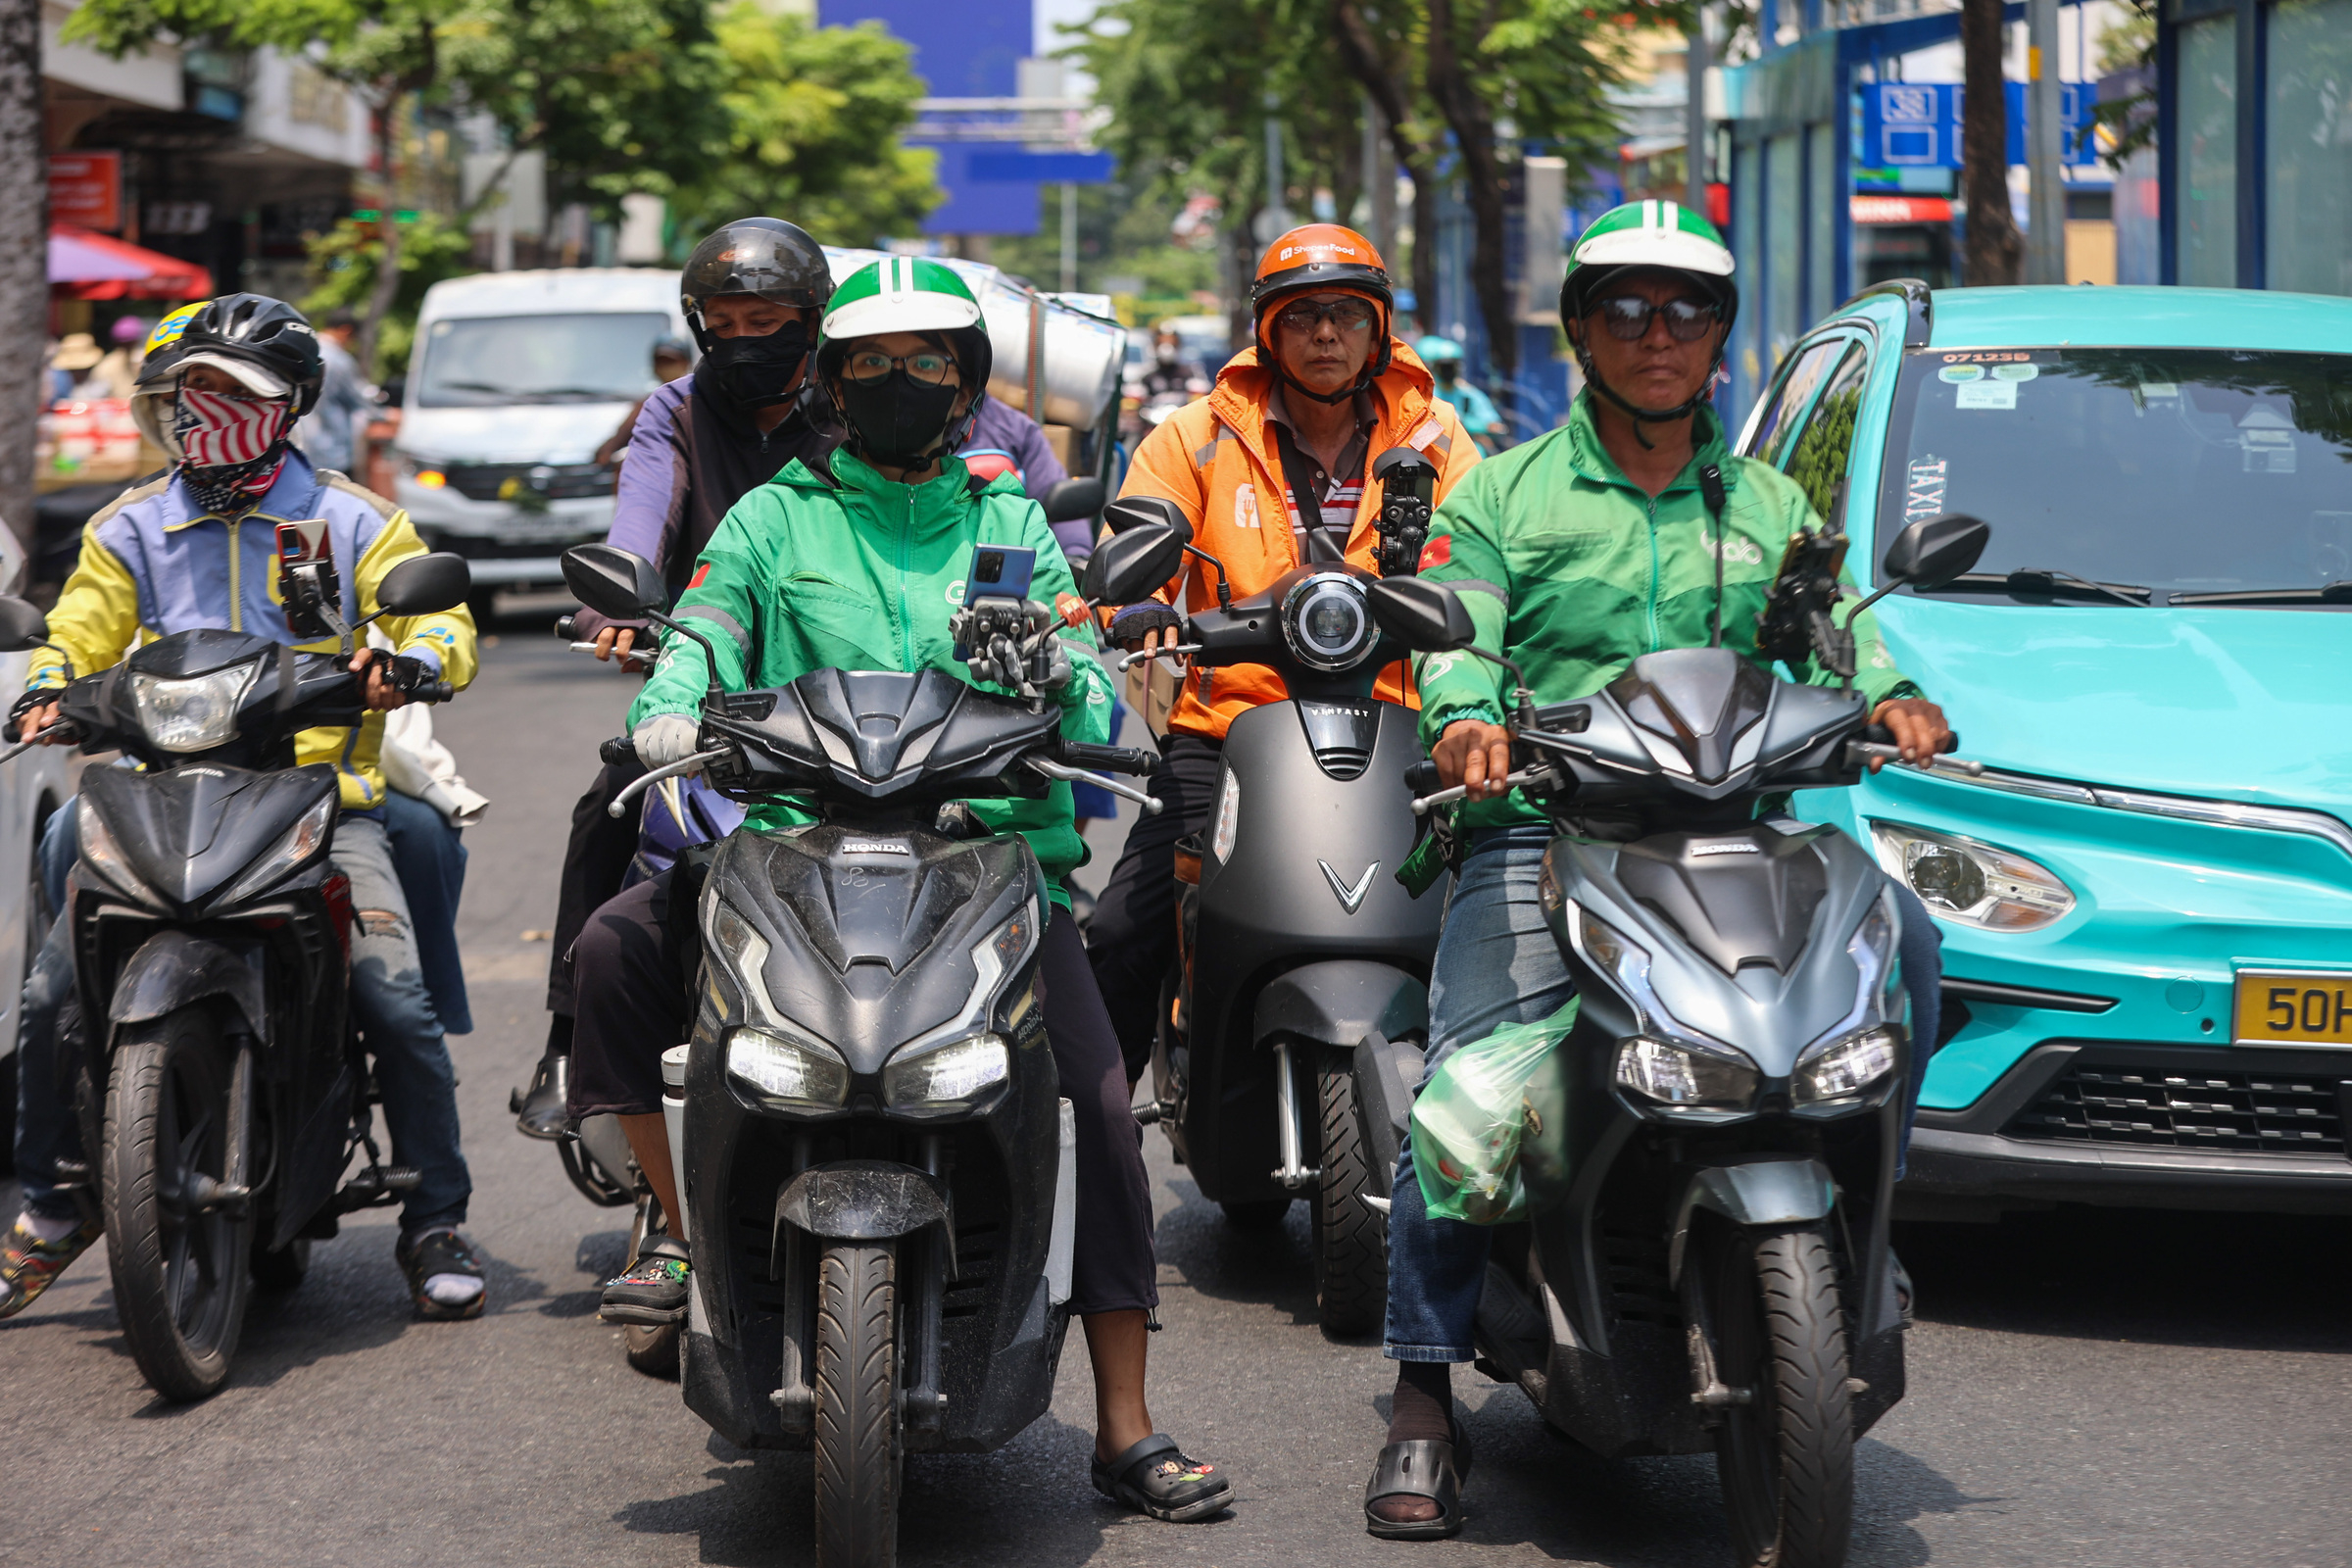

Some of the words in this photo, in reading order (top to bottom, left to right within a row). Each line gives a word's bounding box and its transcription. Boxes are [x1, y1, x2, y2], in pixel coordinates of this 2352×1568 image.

[1294, 243, 1355, 256] ShopeeFood
[1905, 460, 1947, 516] TAXI
[1311, 708, 1369, 717] VINFAST
[843, 843, 910, 854] HONDA
[1690, 843, 1760, 857] HONDA
[2266, 987, 2352, 1034] 50H
